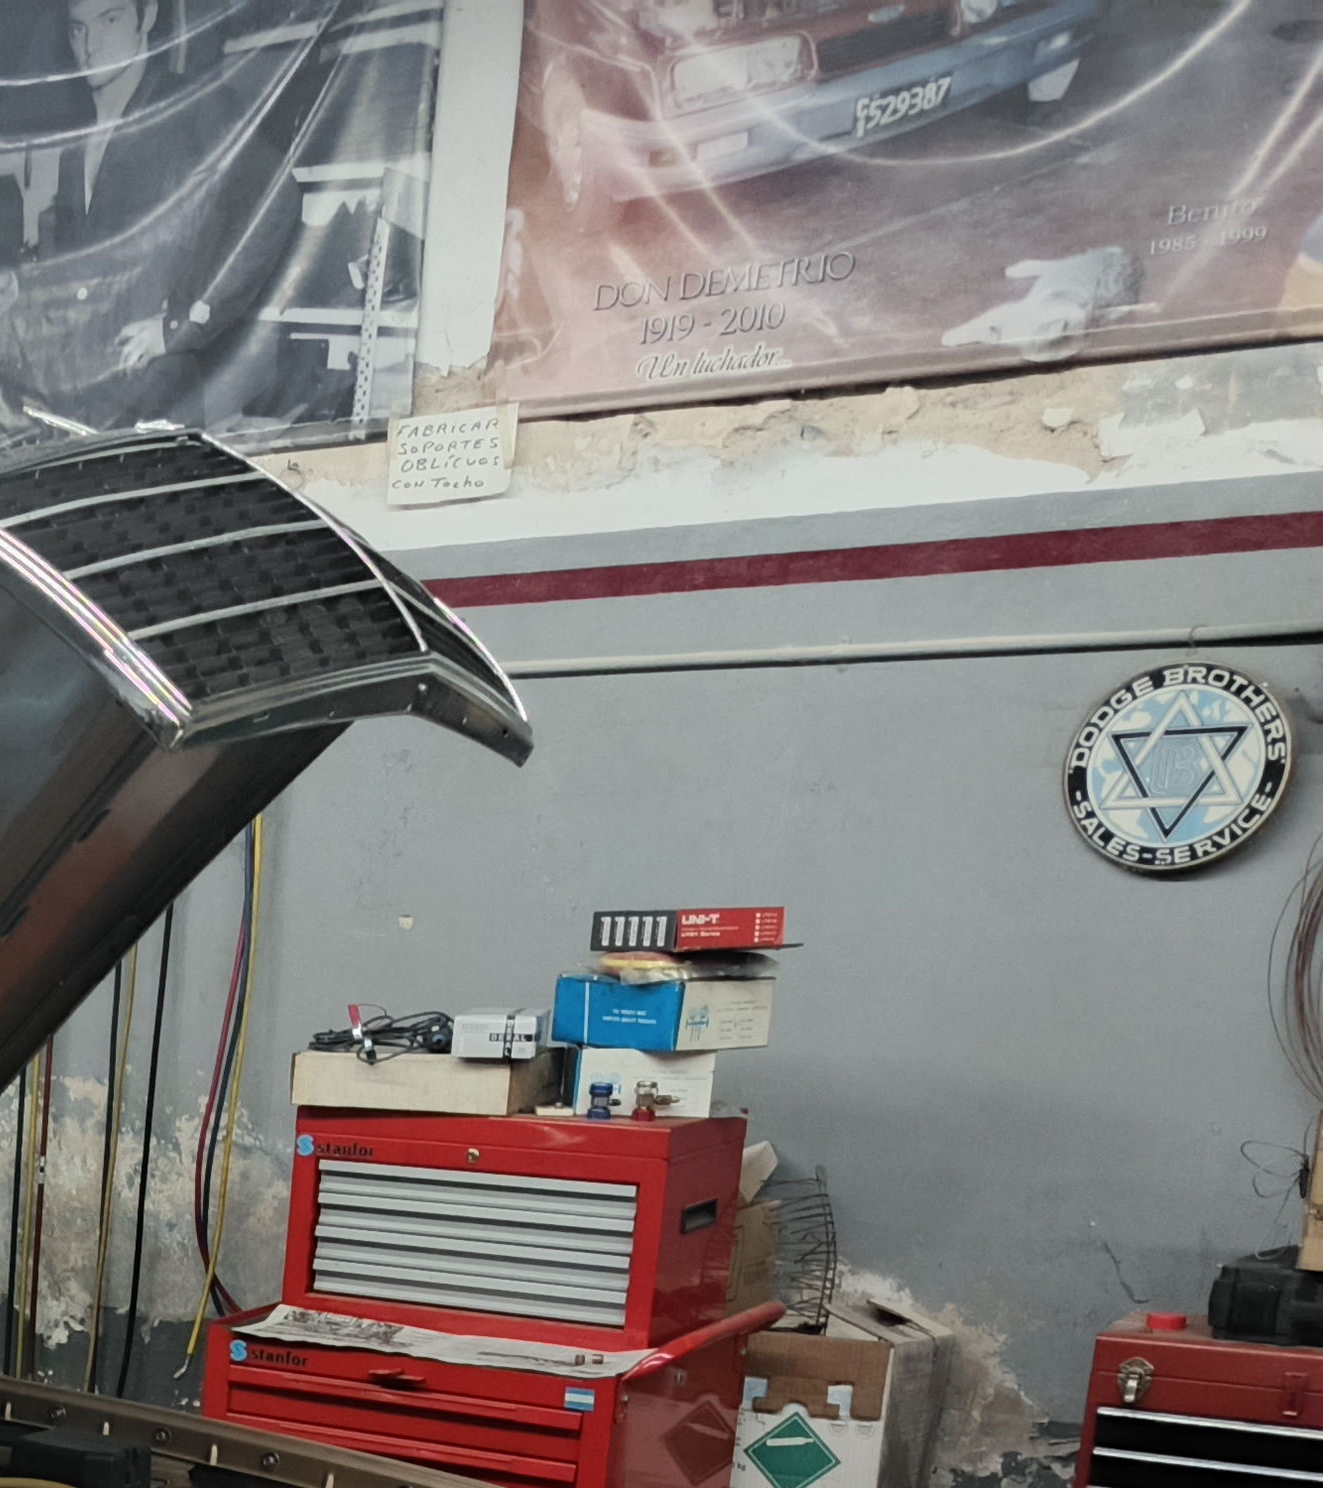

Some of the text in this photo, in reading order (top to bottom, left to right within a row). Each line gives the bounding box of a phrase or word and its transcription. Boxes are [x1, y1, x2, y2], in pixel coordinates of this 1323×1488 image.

[1167, 200, 1256, 226] Benito
[1150, 234, 1197, 256] 1985
[1220, 225, 1268, 247] 1999
[593, 250, 856, 312] DON DEMETRIO
[640, 313, 696, 346] 1919
[718, 301, 787, 336] 2010
[637, 354, 687, 380] Un
[396, 417, 500, 439] FABRICAR
[1070, 665, 1288, 770] DODGE BROTHERS
[681, 914, 721, 925] UNI-T
[317, 1142, 375, 1157] stanfor
[251, 1349, 309, 1367] stanfor
